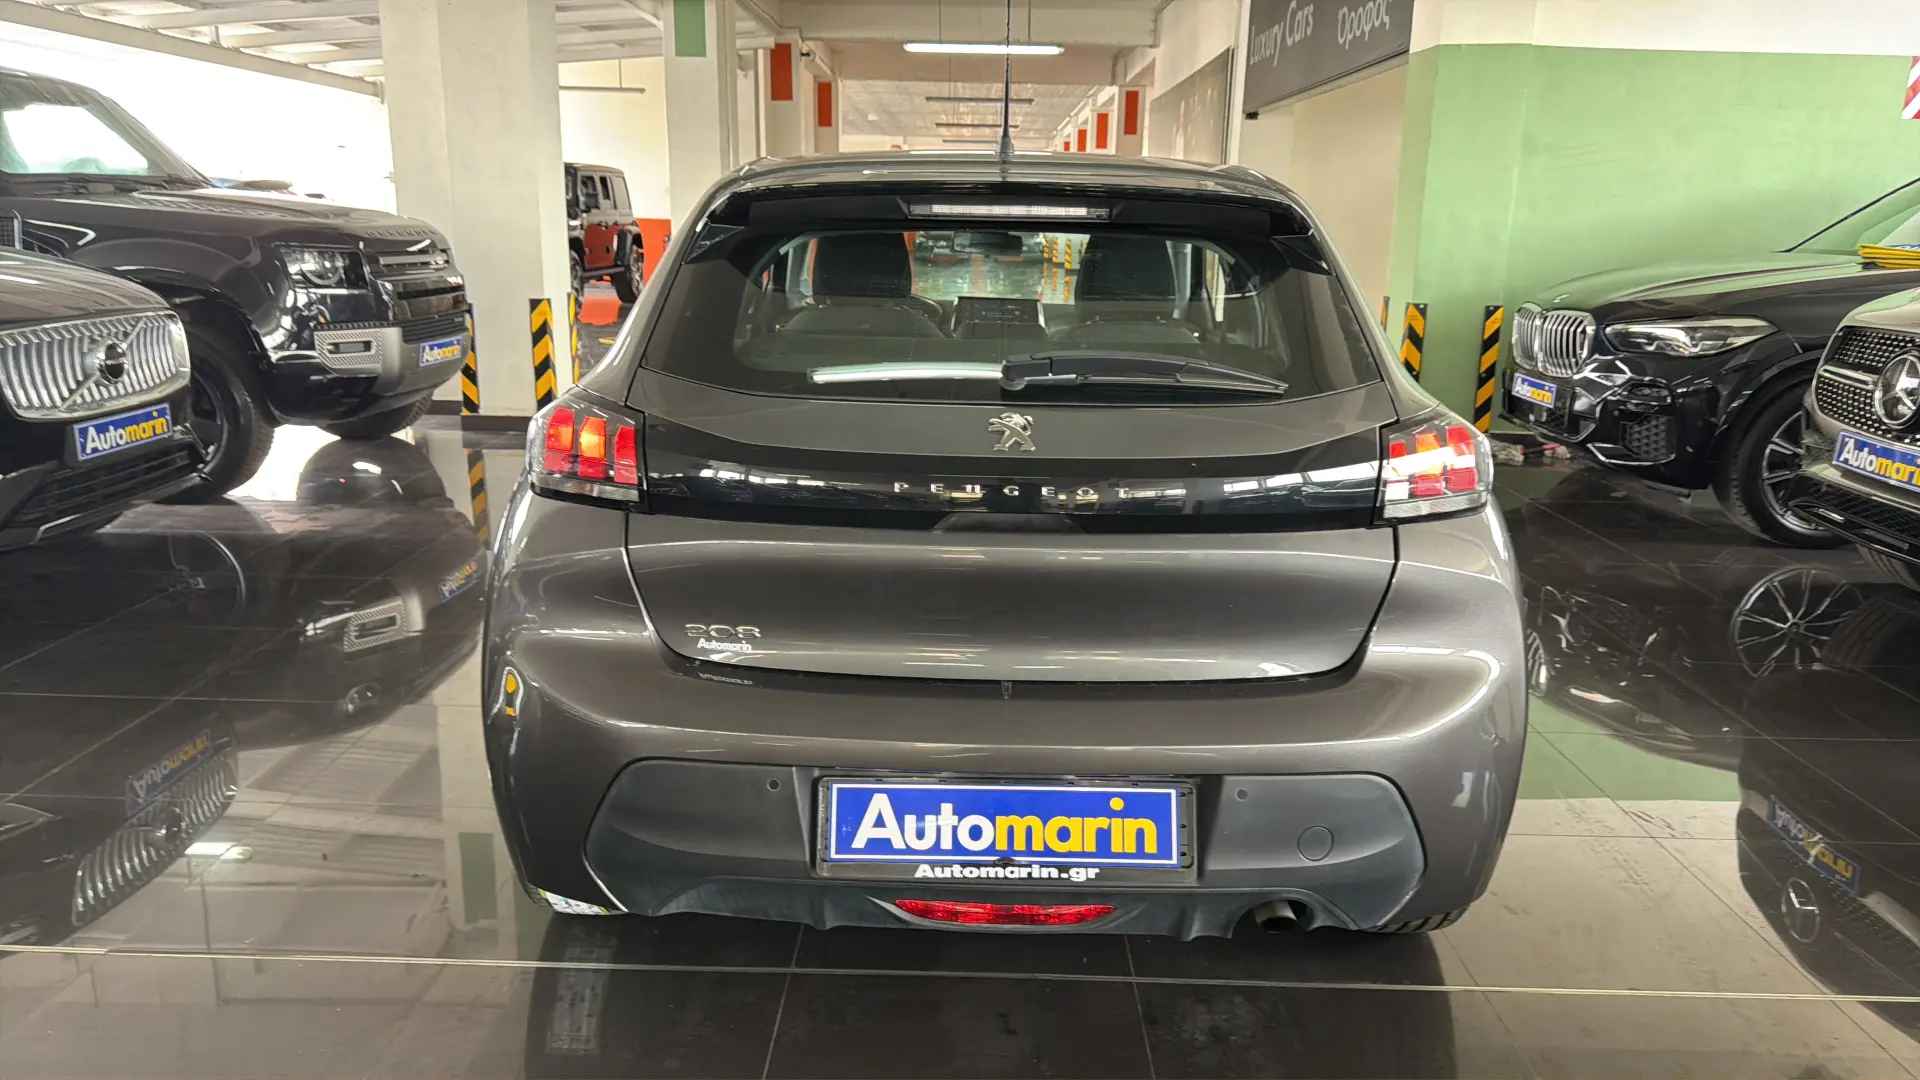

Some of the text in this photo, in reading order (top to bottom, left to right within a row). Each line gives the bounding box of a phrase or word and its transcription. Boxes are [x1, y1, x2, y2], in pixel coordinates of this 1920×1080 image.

[1249, 0, 1314, 67] Luxury Cars
[423, 341, 461, 363] Automarin
[1515, 377, 1553, 404] Automarin
[86, 411, 168, 454] Automarin
[1839, 438, 1920, 487] Automari
[894, 482, 1130, 498] PEUGEOT
[684, 624, 762, 639] 208
[697, 637, 752, 653] Automarin
[850, 792, 1158, 854] Automarin
[914, 864, 1100, 882] Automarin.gr
